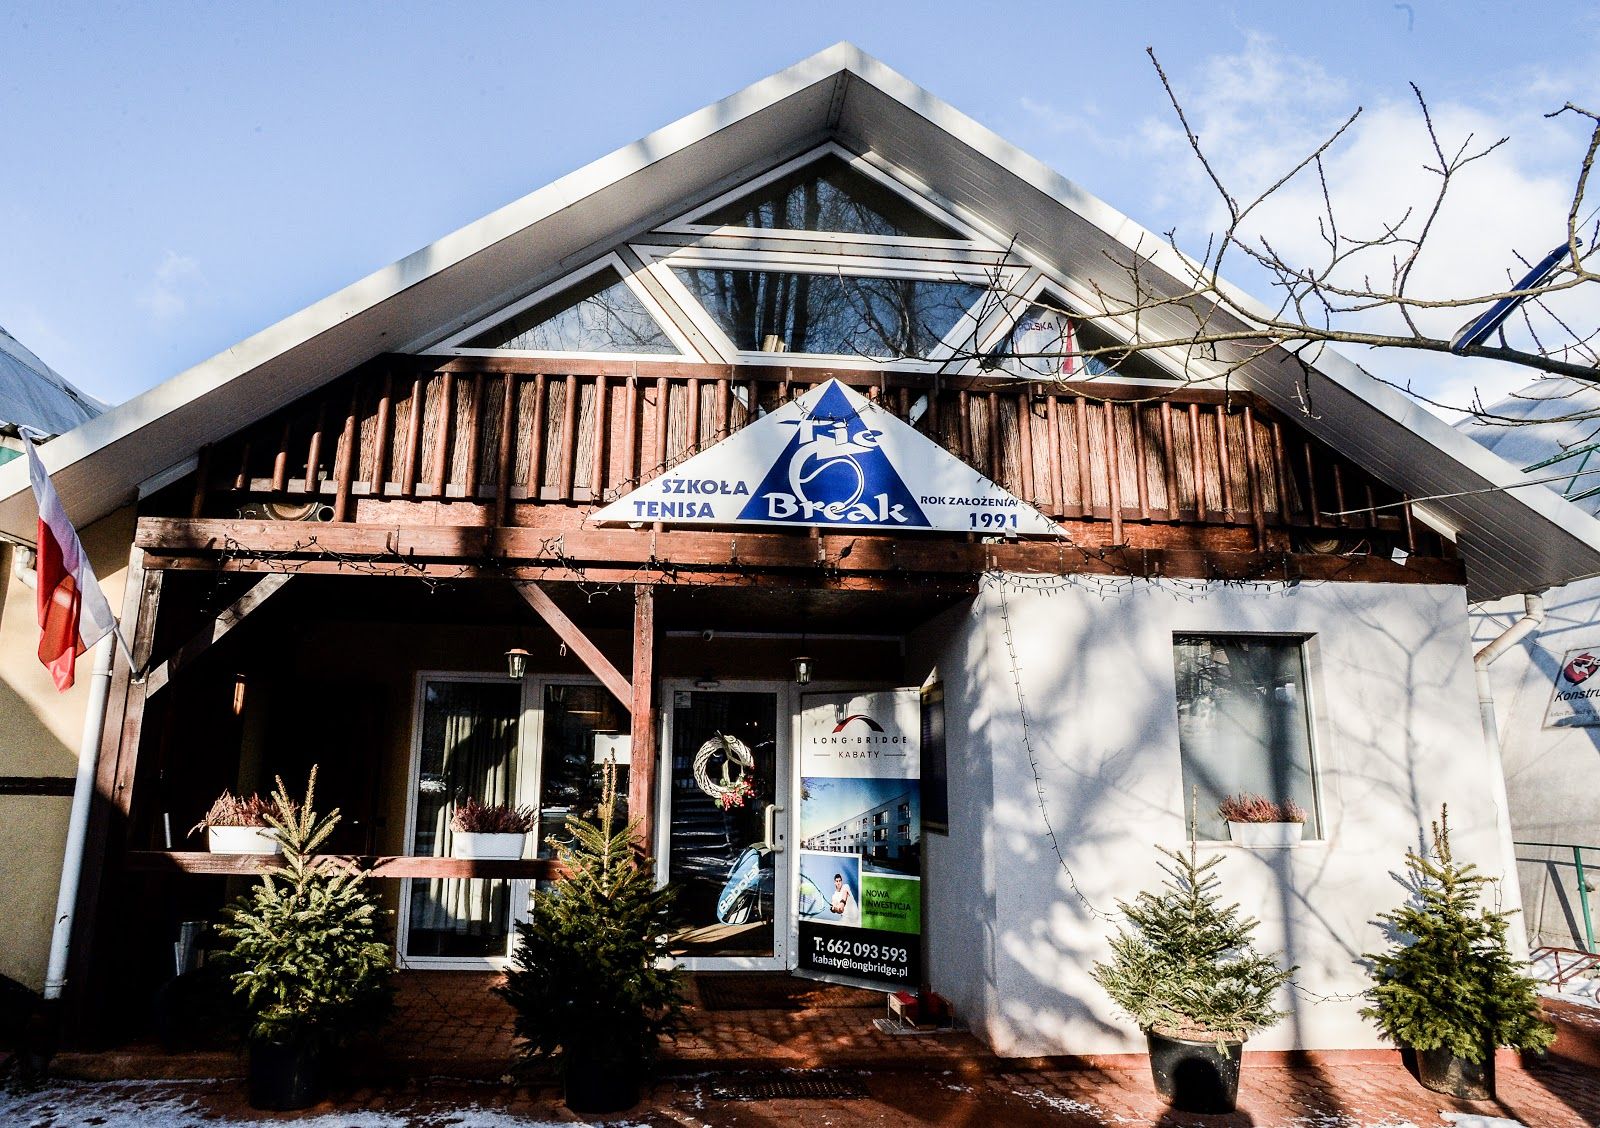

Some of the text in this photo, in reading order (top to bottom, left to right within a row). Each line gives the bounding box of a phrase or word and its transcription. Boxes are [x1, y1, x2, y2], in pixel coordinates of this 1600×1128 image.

[777, 418, 884, 448] Tie
[662, 479, 749, 495] SZKOŁA
[633, 500, 715, 518] TENISA
[762, 492, 908, 523] Break
[920, 496, 1017, 507] ROK ZAŁOŻENIA
[970, 513, 1018, 528] 1991
[866, 889, 890, 899] NOWA
[866, 900, 912, 911] INWESTYCJA
[813, 936, 908, 962] T: 662 093 593
[812, 953, 908, 977] kabaty@longbridge.pl
